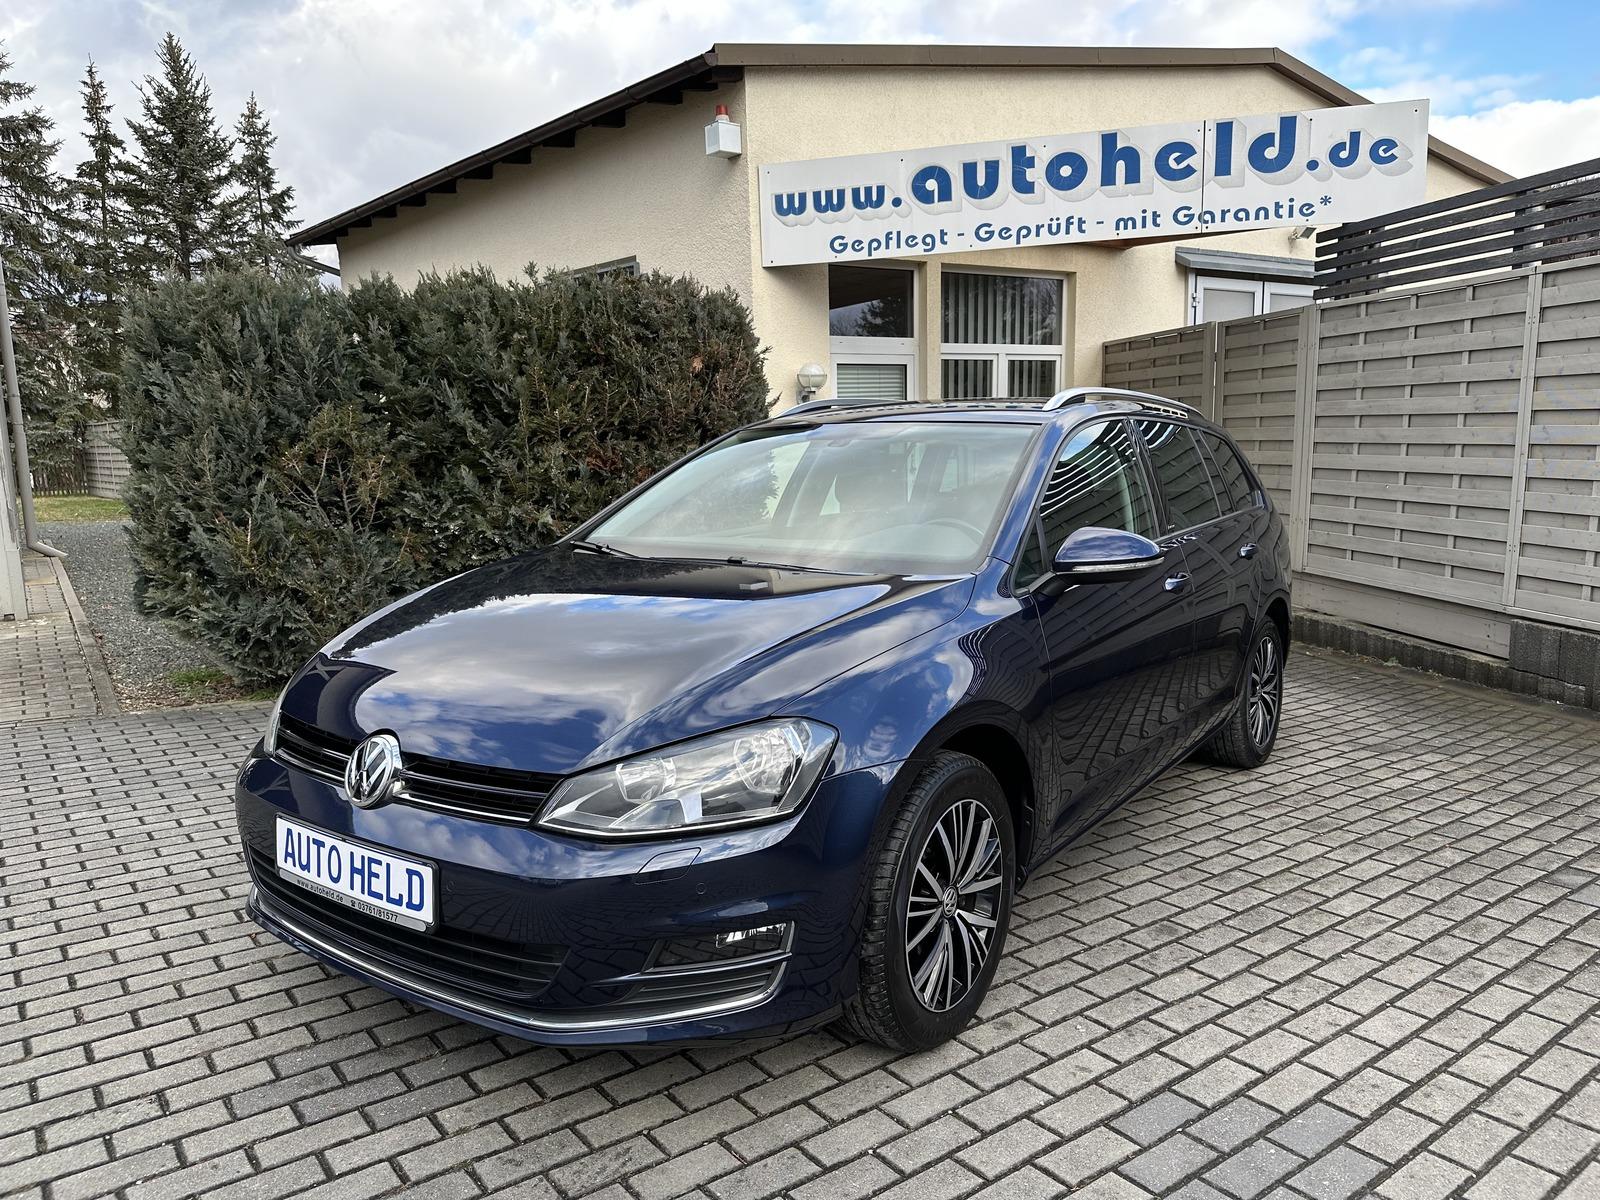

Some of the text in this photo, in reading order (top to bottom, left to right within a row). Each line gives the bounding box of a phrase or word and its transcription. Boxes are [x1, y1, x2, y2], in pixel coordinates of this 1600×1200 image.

[775, 115, 1399, 217] www.autoheld.de
[829, 228, 949, 257] Gepflegt
[974, 215, 1088, 245] Geprüft
[1114, 208, 1162, 232] mit
[283, 827, 425, 912] AUTO HELD
[296, 879, 399, 923] www.autoheld.de 03761/81577
